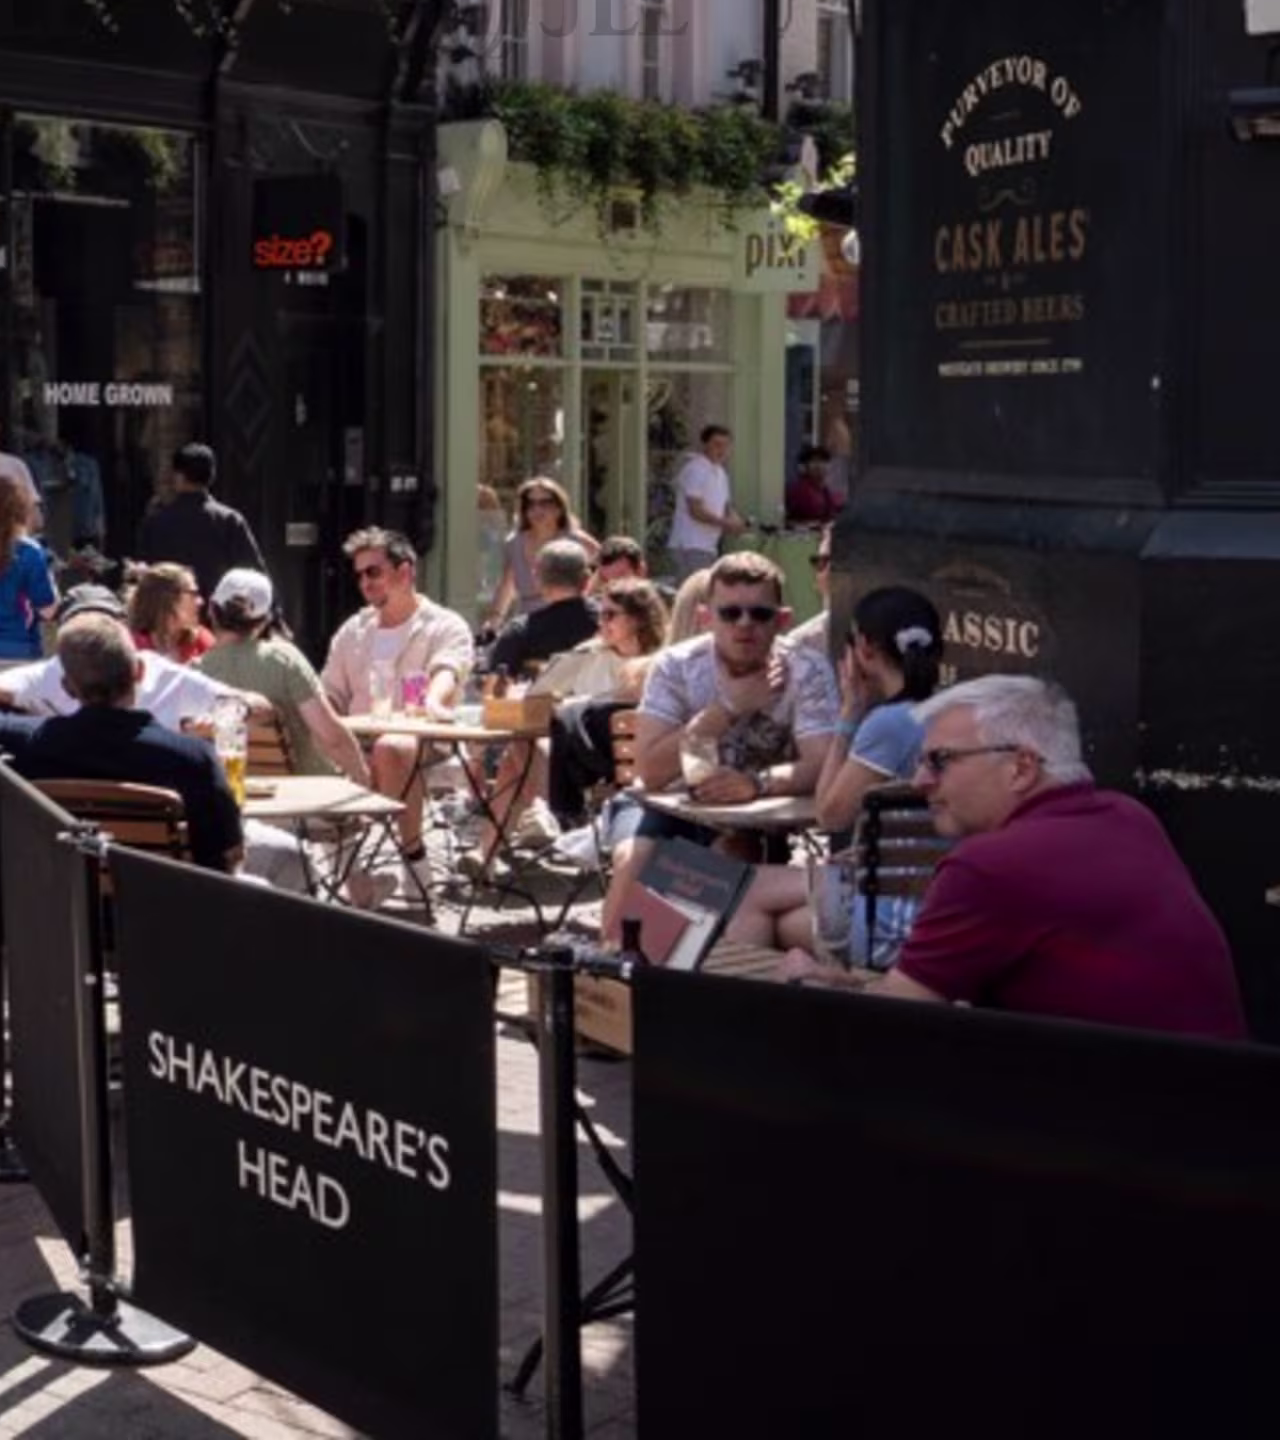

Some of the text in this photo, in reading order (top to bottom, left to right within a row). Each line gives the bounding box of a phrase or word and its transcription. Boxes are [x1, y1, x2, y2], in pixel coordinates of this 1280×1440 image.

[940, 55, 1082, 149] PURVEYOR OF
[965, 129, 1053, 177] QUALITY
[255, 231, 332, 266] size?
[935, 209, 1086, 273] CASK ALES
[43, 382, 173, 406] HOME GROWN
[942, 611, 1040, 659] ASSIC
[146, 1030, 452, 1191] SHAKESPEARE'S
[237, 1139, 350, 1231] HEAD
